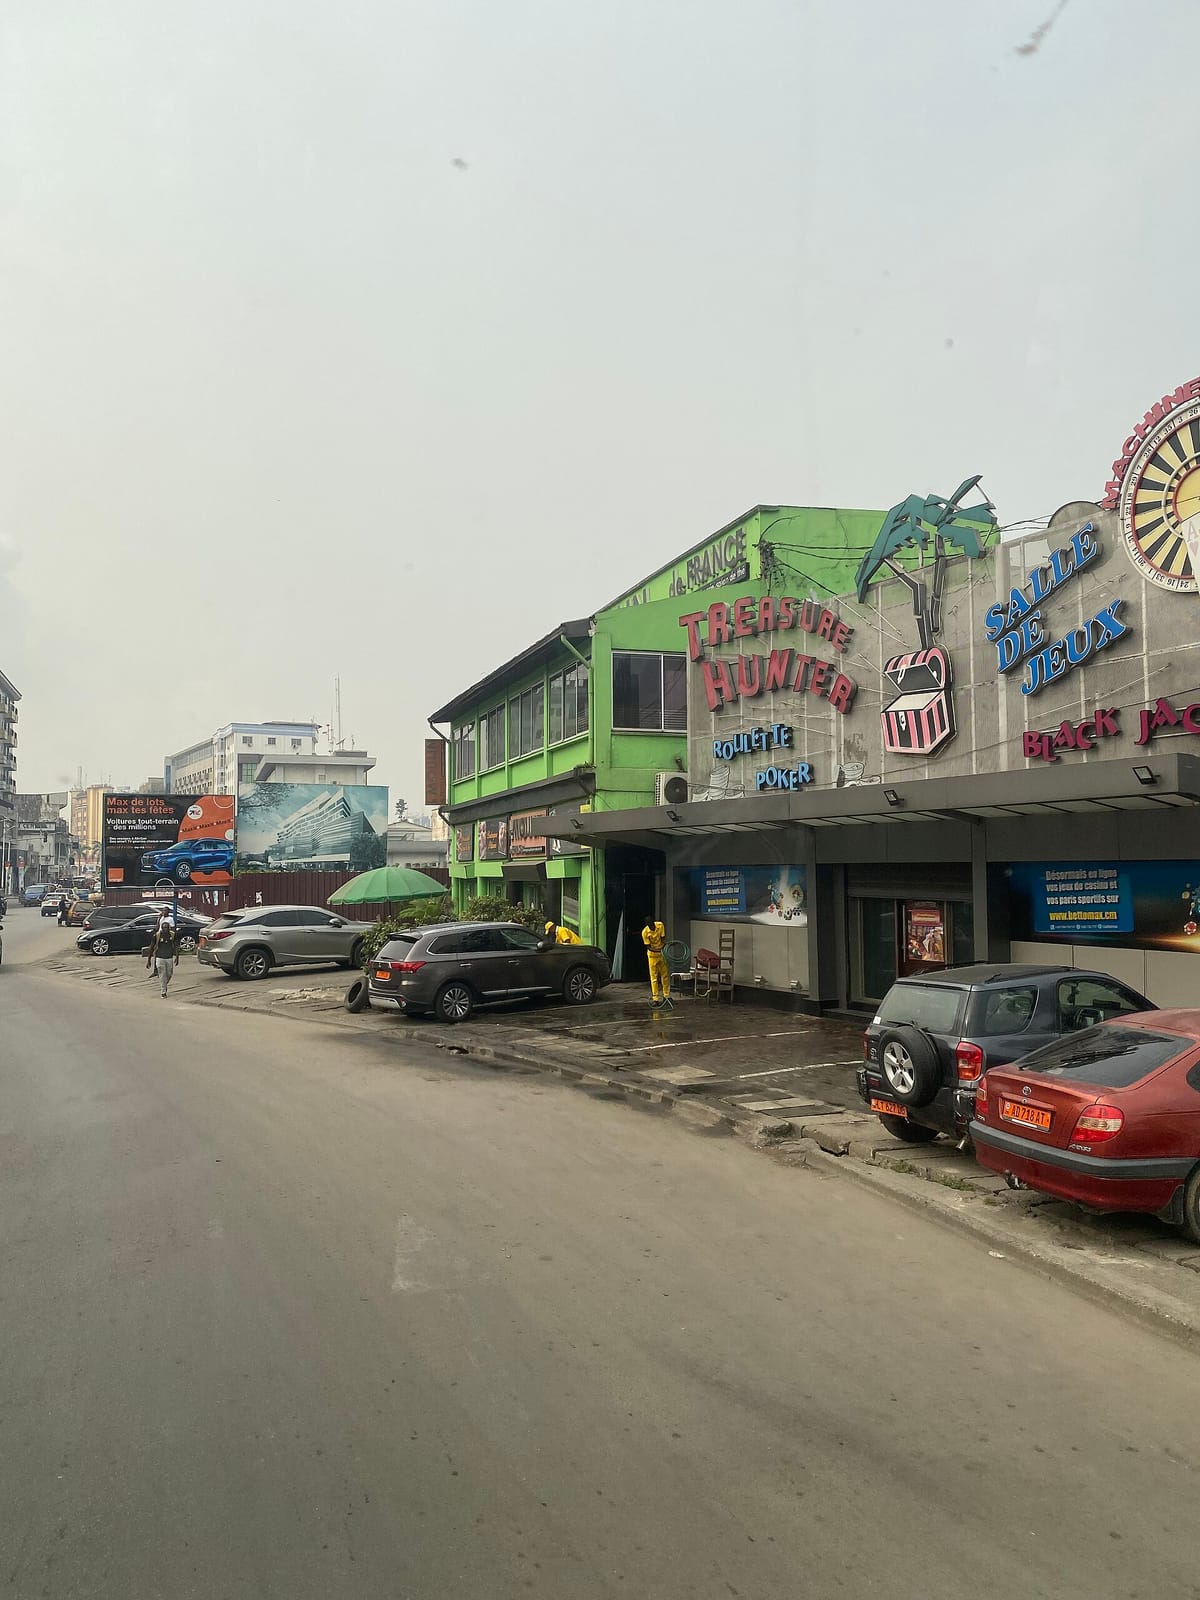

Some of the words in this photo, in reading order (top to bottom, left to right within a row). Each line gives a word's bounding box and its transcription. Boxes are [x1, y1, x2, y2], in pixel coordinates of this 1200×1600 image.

[686, 528, 747, 589] FRANCE
[985, 521, 1098, 641] SALLE
[679, 596, 853, 662] TREASURE
[996, 610, 1044, 673] DE
[1021, 599, 1128, 695] JEUX
[702, 649, 856, 714] HUNTER
[713, 723, 792, 761] ROULETTE
[1022, 707, 1120, 762] BLACK
[106, 797, 128, 806] Max
[131, 798, 144, 806] de
[146, 797, 165, 806] lots
[756, 762, 813, 791] POKER
[150, 806, 174, 814] fêtes
